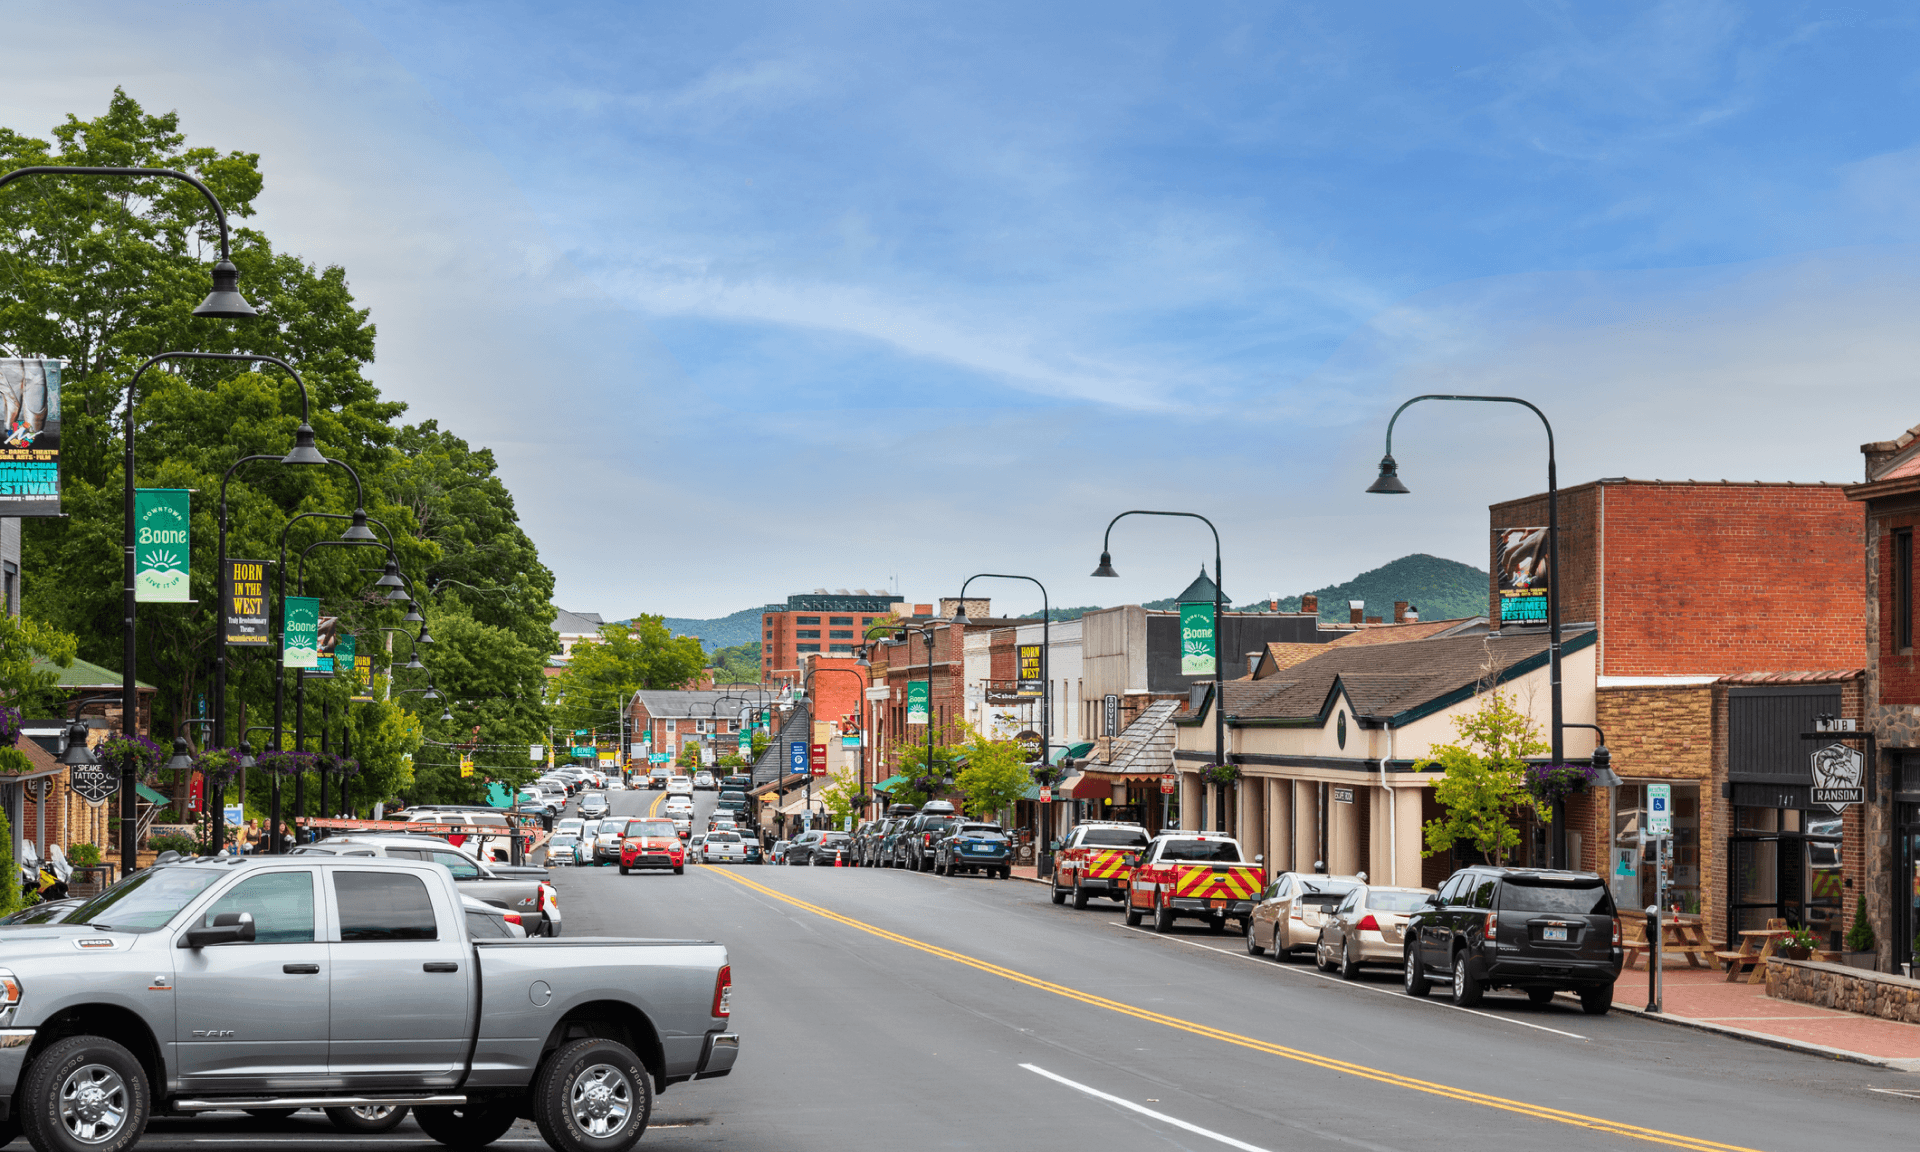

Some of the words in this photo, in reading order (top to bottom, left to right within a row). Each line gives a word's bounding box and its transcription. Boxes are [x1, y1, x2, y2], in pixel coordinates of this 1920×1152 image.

[0, 470, 58, 482] UMMER
[0, 482, 58, 494] STIVAL
[142, 506, 182, 520] DOWNTOWN
[138, 527, 186, 544] Boone
[233, 563, 264, 580] HORN
[146, 576, 160, 588] LIVE
[171, 577, 180, 586] UP
[234, 582, 244, 596] IN
[244, 582, 262, 596] THE
[232, 598, 262, 614] WEST
[1502, 602, 1548, 611] SUMMER
[1502, 610, 1548, 620] FESTIVAL
[286, 620, 316, 632] Boone
[1183, 628, 1212, 639] Boone
[1021, 646, 1040, 658] HORN
[1029, 658, 1039, 667] THE
[1022, 668, 1040, 678] WEST
[1826, 720, 1848, 730] PUB
[1817, 790, 1858, 801] RANSOM
